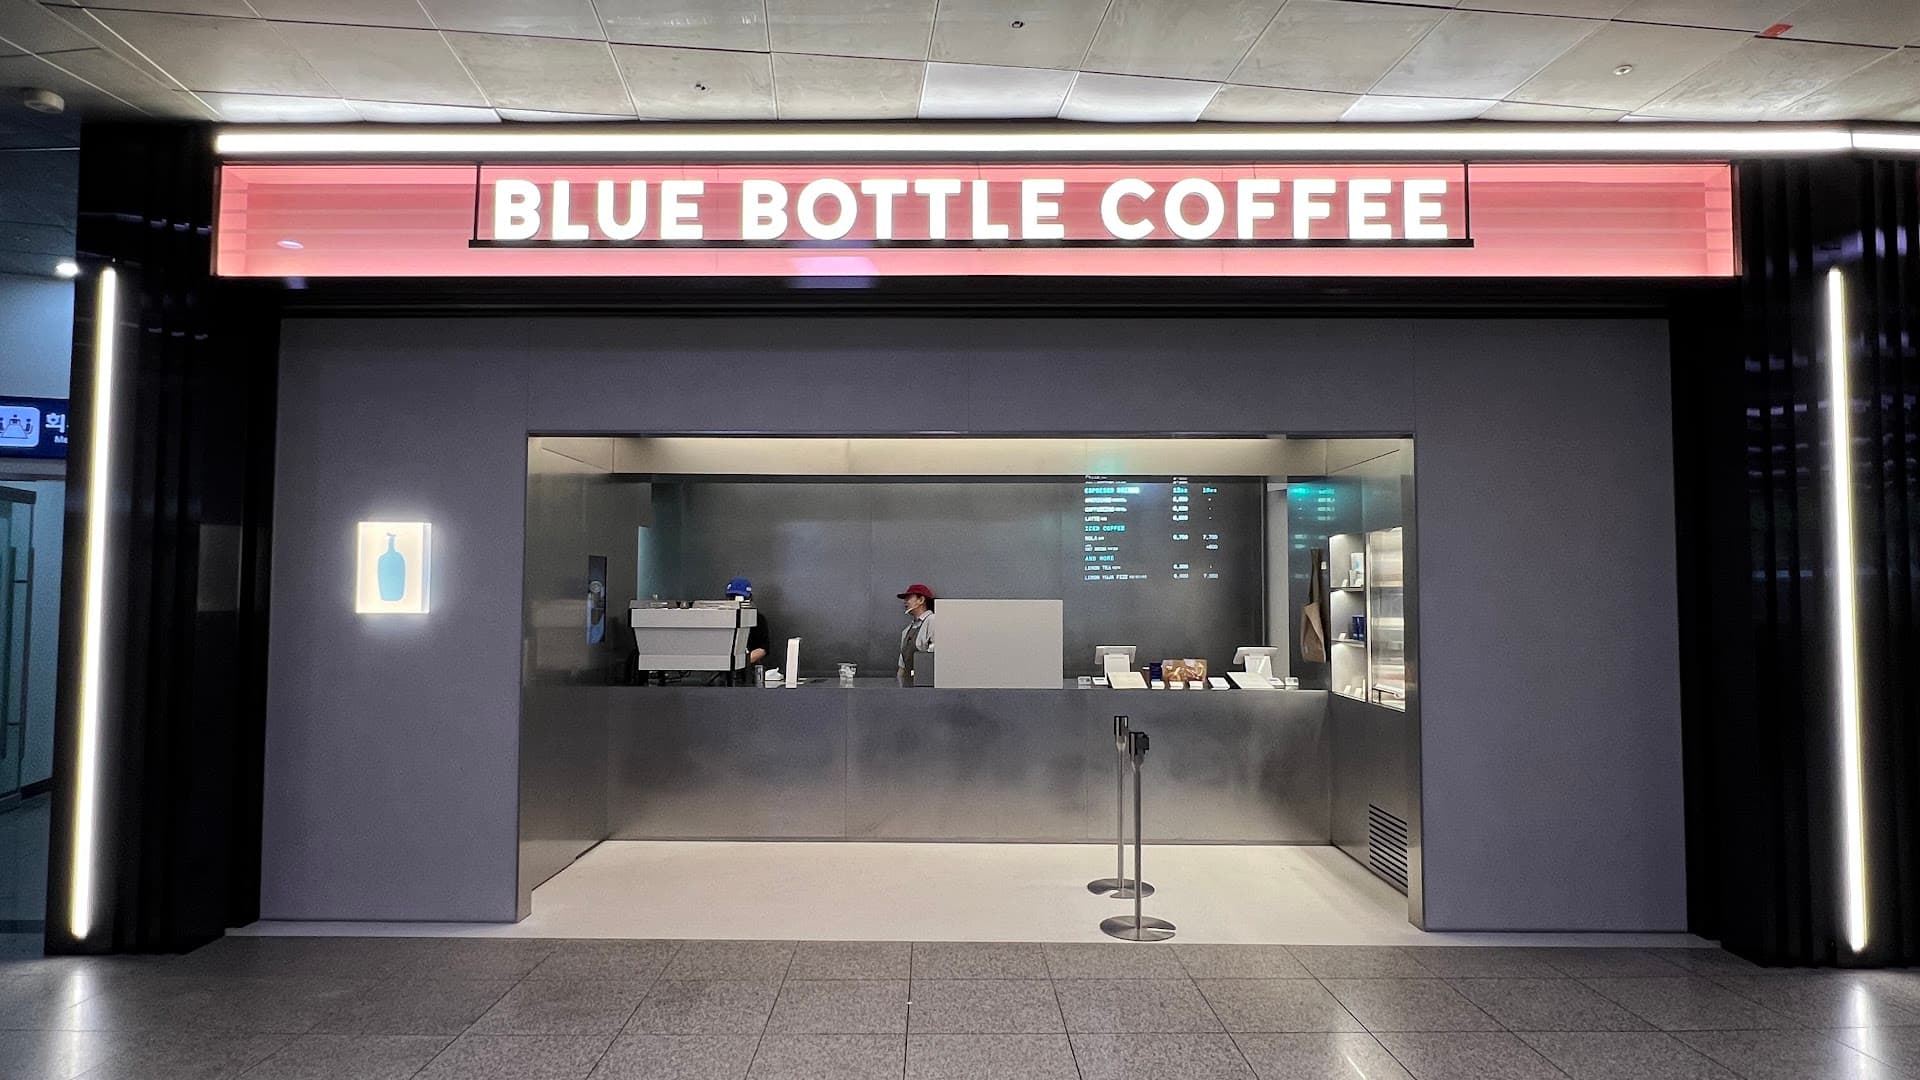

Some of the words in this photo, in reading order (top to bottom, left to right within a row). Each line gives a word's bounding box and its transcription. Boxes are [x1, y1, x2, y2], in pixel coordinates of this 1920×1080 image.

[494, 179, 704, 240] BLUE
[742, 178, 1065, 240] BOTTLE
[1101, 178, 1448, 240] COFFEE
[45, 412, 69, 433] 회
